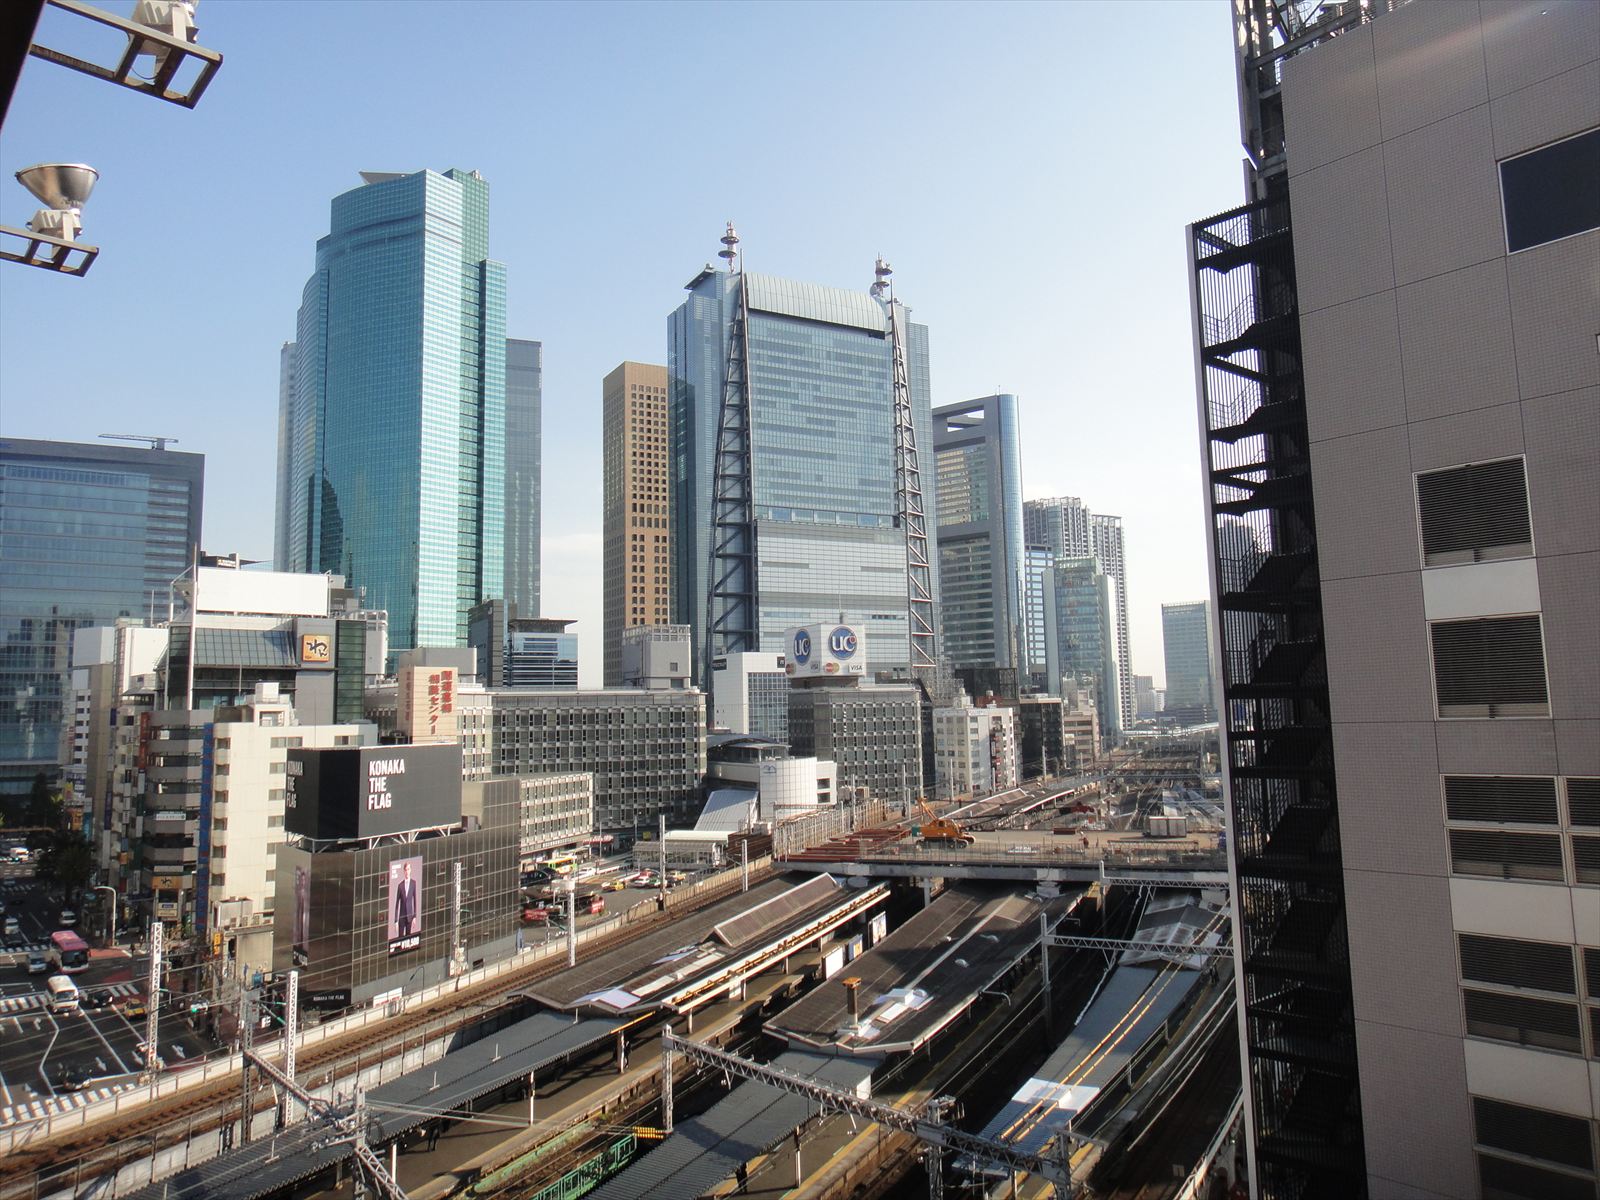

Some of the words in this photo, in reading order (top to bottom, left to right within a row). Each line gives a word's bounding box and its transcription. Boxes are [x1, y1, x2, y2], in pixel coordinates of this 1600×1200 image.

[794, 639, 810, 656] UC
[832, 635, 855, 652] UC
[368, 759, 406, 776] KONAKA
[369, 777, 387, 793] THE
[368, 793, 393, 811] FLAG
